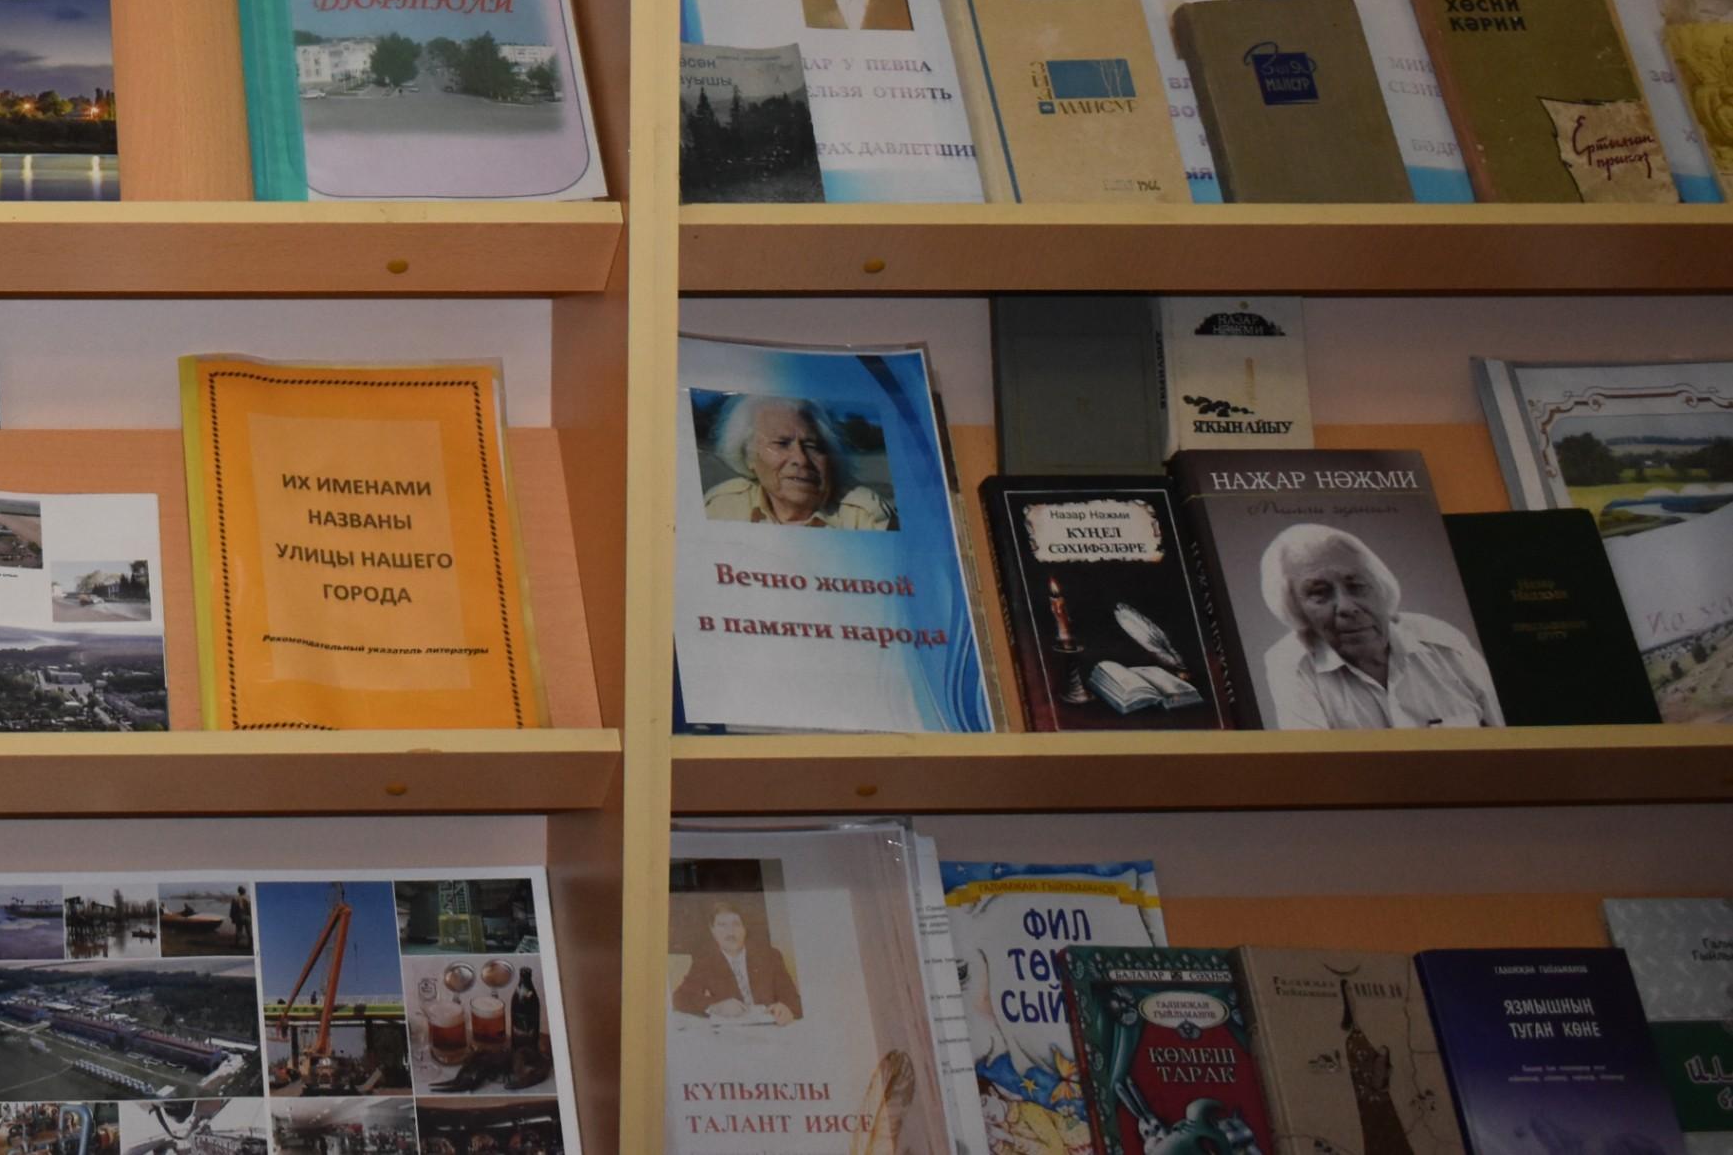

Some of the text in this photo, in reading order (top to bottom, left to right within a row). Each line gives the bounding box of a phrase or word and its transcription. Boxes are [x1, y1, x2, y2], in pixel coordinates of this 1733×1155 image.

[1450, 16, 1527, 33] КӘРИМ
[843, 58, 933, 75] У ПЕВЦА
[872, 86, 952, 102] ОТНЯТЬ
[1265, 76, 1311, 96] МАНСУР
[282, 474, 432, 496] ИХ ИМЕНАМИ
[308, 509, 412, 530] НАЗВАНЫ
[1049, 508, 1080, 522] Назар
[1065, 526, 1123, 542] КҮҢЕЛ
[275, 543, 453, 569] УЛИЦЫ НАШЕГО
[1047, 541, 1147, 556] СӘХИФӘЛӘРЕ
[715, 562, 916, 597] Вечно живой
[323, 583, 412, 606] ГОРОДА
[698, 614, 947, 649] в памяти народа
[262, 633, 489, 656] Рекомендательный указатель литературы
[1023, 908, 1092, 942] ФИЛ
[1113, 970, 1166, 981] БАЛАЛАР
[1509, 1021, 1602, 1039] ТУГАН КӨНЕ
[1149, 1049, 1236, 1065] КӨМЕШ
[1156, 1066, 1236, 1084] ТАРАК
[683, 1081, 831, 1103] КҮПЬЯКЛЫ
[685, 1114, 872, 1136] ТАЛАНТ ИЯСЕ
